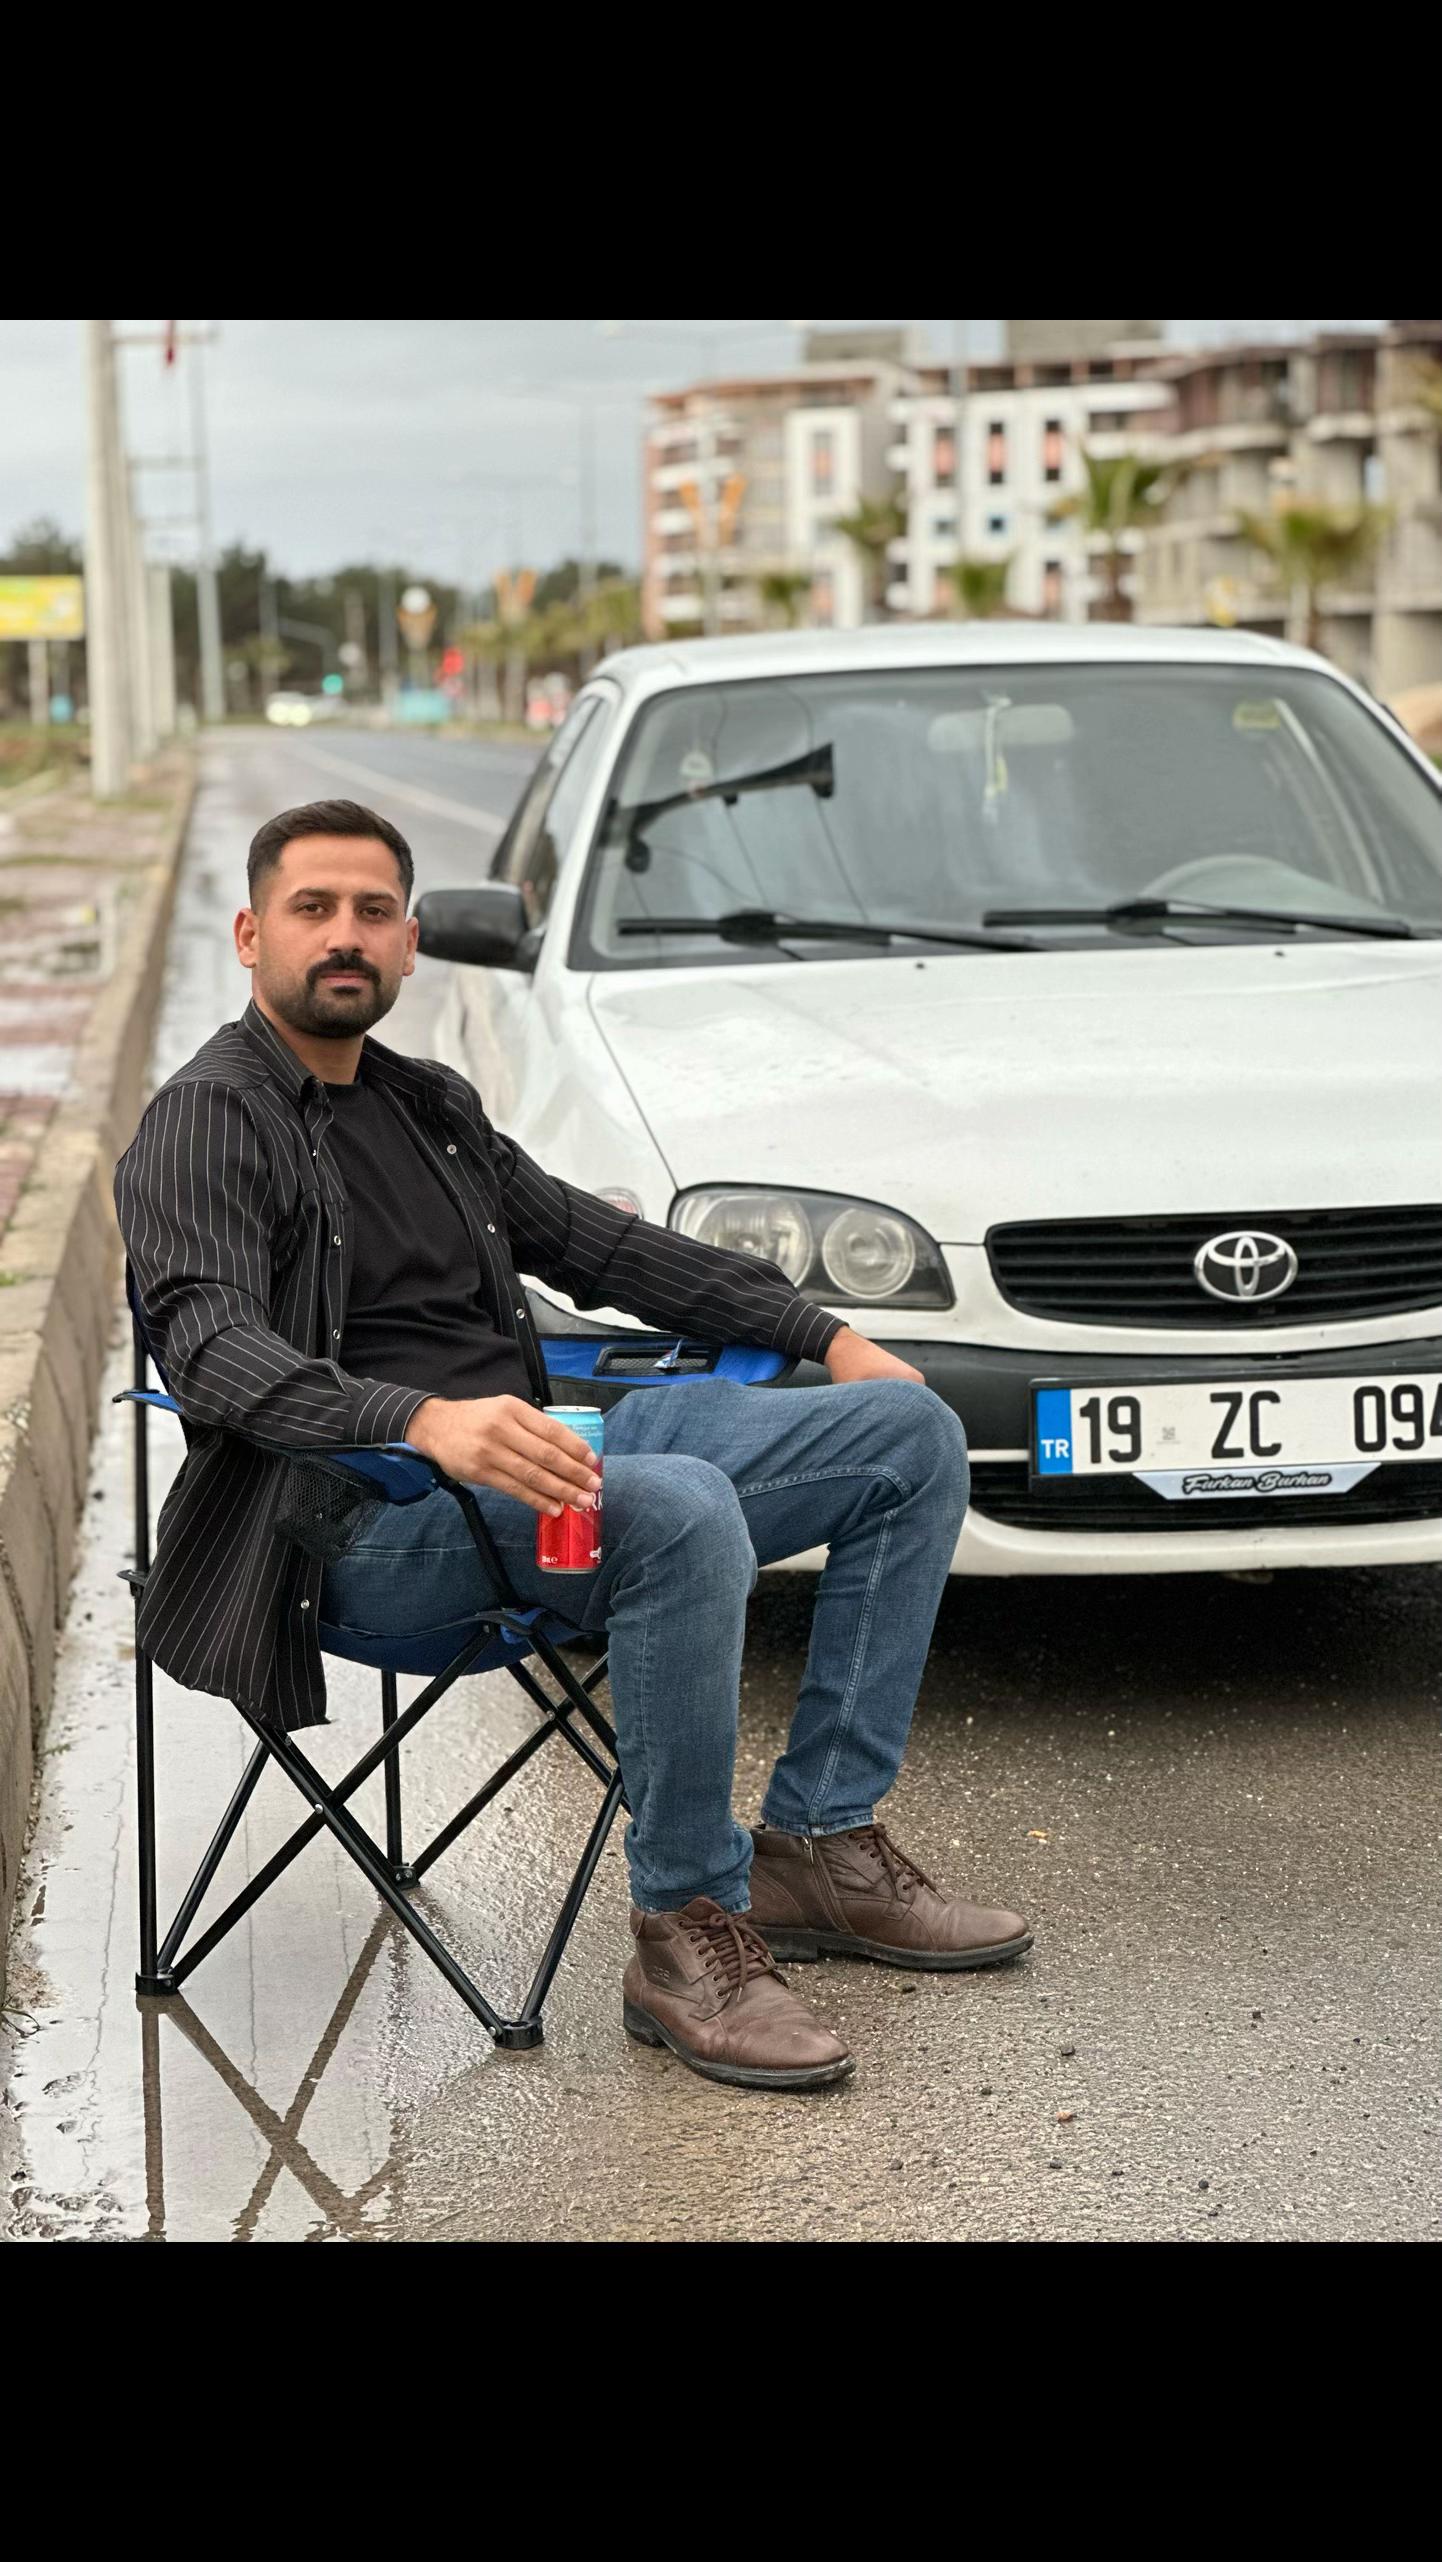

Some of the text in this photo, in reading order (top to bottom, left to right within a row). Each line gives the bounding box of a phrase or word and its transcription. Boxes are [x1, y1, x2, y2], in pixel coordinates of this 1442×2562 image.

[1079, 1395, 1142, 1464] 19
[1209, 1389, 1282, 1459] ZC
[1041, 1439, 1070, 1459] TR
[1183, 1471, 1332, 1494] Furkan Burhan
